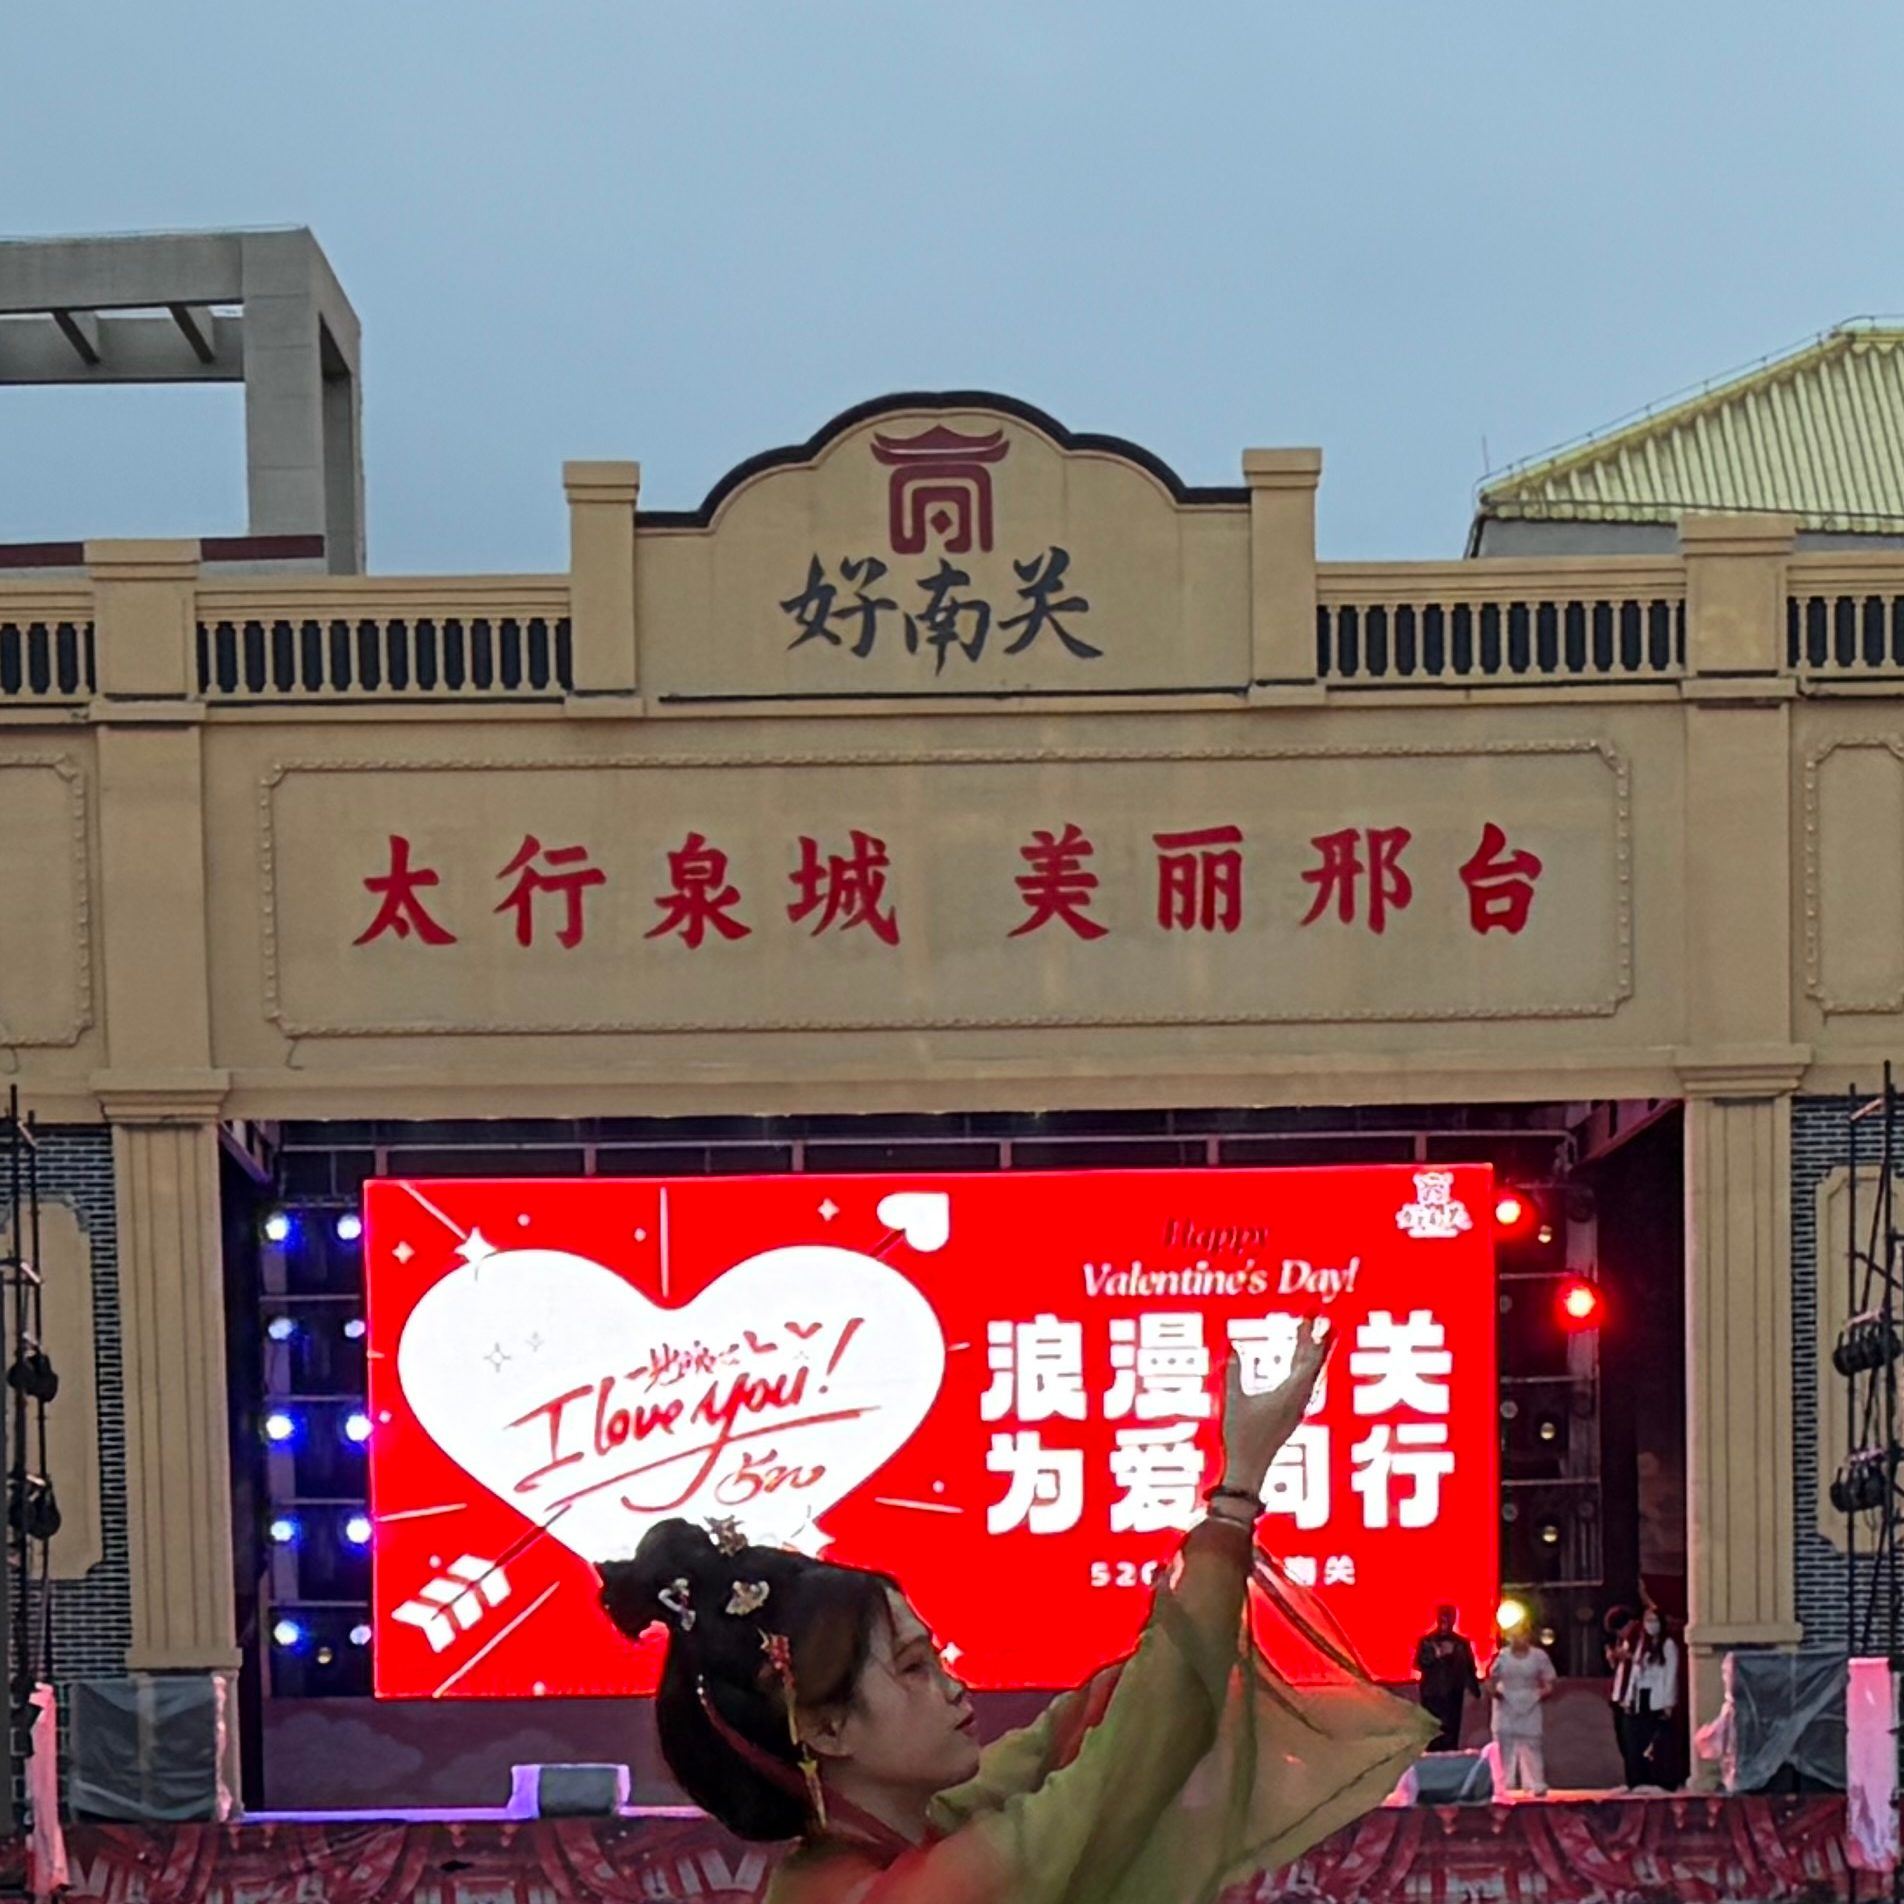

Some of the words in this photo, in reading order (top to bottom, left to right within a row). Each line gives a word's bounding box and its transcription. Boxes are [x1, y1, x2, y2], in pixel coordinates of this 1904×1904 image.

[779, 545, 1104, 677] 好南关
[352, 831, 900, 950] 太行泉城
[1007, 822, 1542, 941] 美丽邢台
[1160, 1217, 1273, 1258] Happy
[1083, 1259, 1268, 1297] Valentine's
[1277, 1256, 1361, 1304] Day!
[594, 1375, 685, 1457] love
